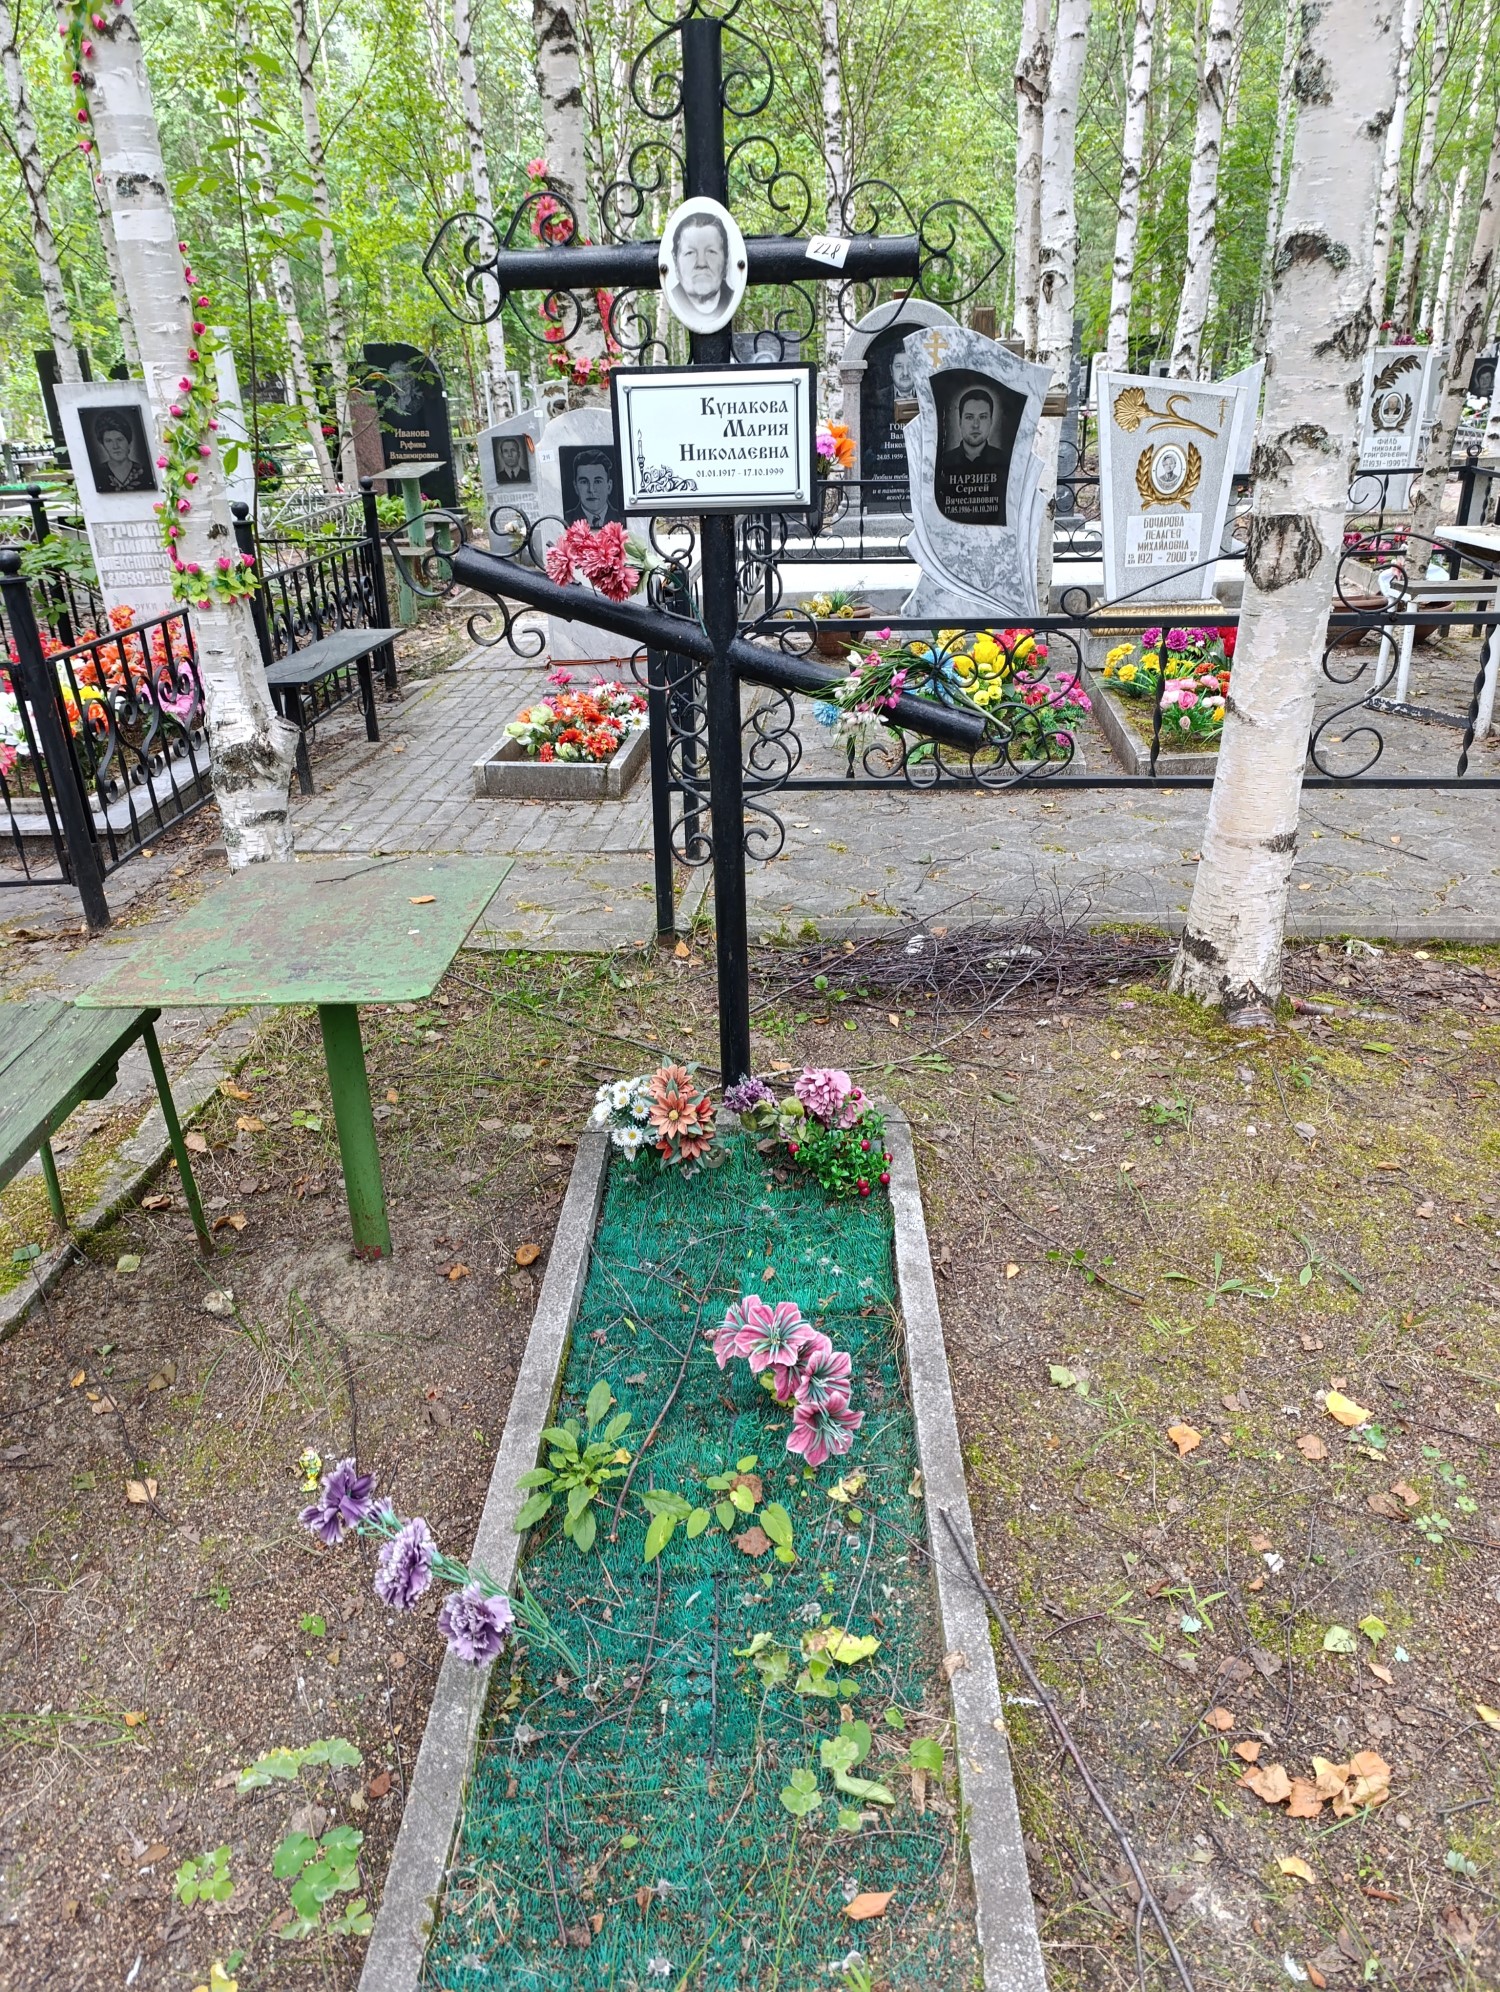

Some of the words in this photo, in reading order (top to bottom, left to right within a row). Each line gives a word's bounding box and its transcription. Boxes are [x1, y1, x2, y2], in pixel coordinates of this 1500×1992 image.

[813, 242, 842, 260] 228
[700, 397, 788, 419] Кунакова
[394, 428, 430, 438] Иванова
[723, 419, 789, 438] Мария
[890, 432, 905, 440] Вал
[400, 440, 427, 450] Руфина
[884, 441, 906, 449] Никол
[389, 451, 439, 460] Владимировна
[679, 443, 790, 462] Николаевна
[696, 468, 736, 478] 01.01.1917
[743, 467, 784, 477] 17.10.1999
[949, 473, 998, 484] НАРЗИЕВ
[955, 484, 989, 495] Сергей
[945, 496, 999, 505] Вячеславович
[1144, 515, 1184, 529] БОЧАРОВА
[1145, 528, 1182, 540] ПЕЛАГЕЯ
[1137, 540, 1189, 552] МИХАЙЛОВНА
[99, 553, 170, 571] АЛЕКСАНДРО
[1138, 552, 1153, 564] 1921
[1166, 551, 1187, 563] 2000
[115, 570, 171, 585] 1939-199
